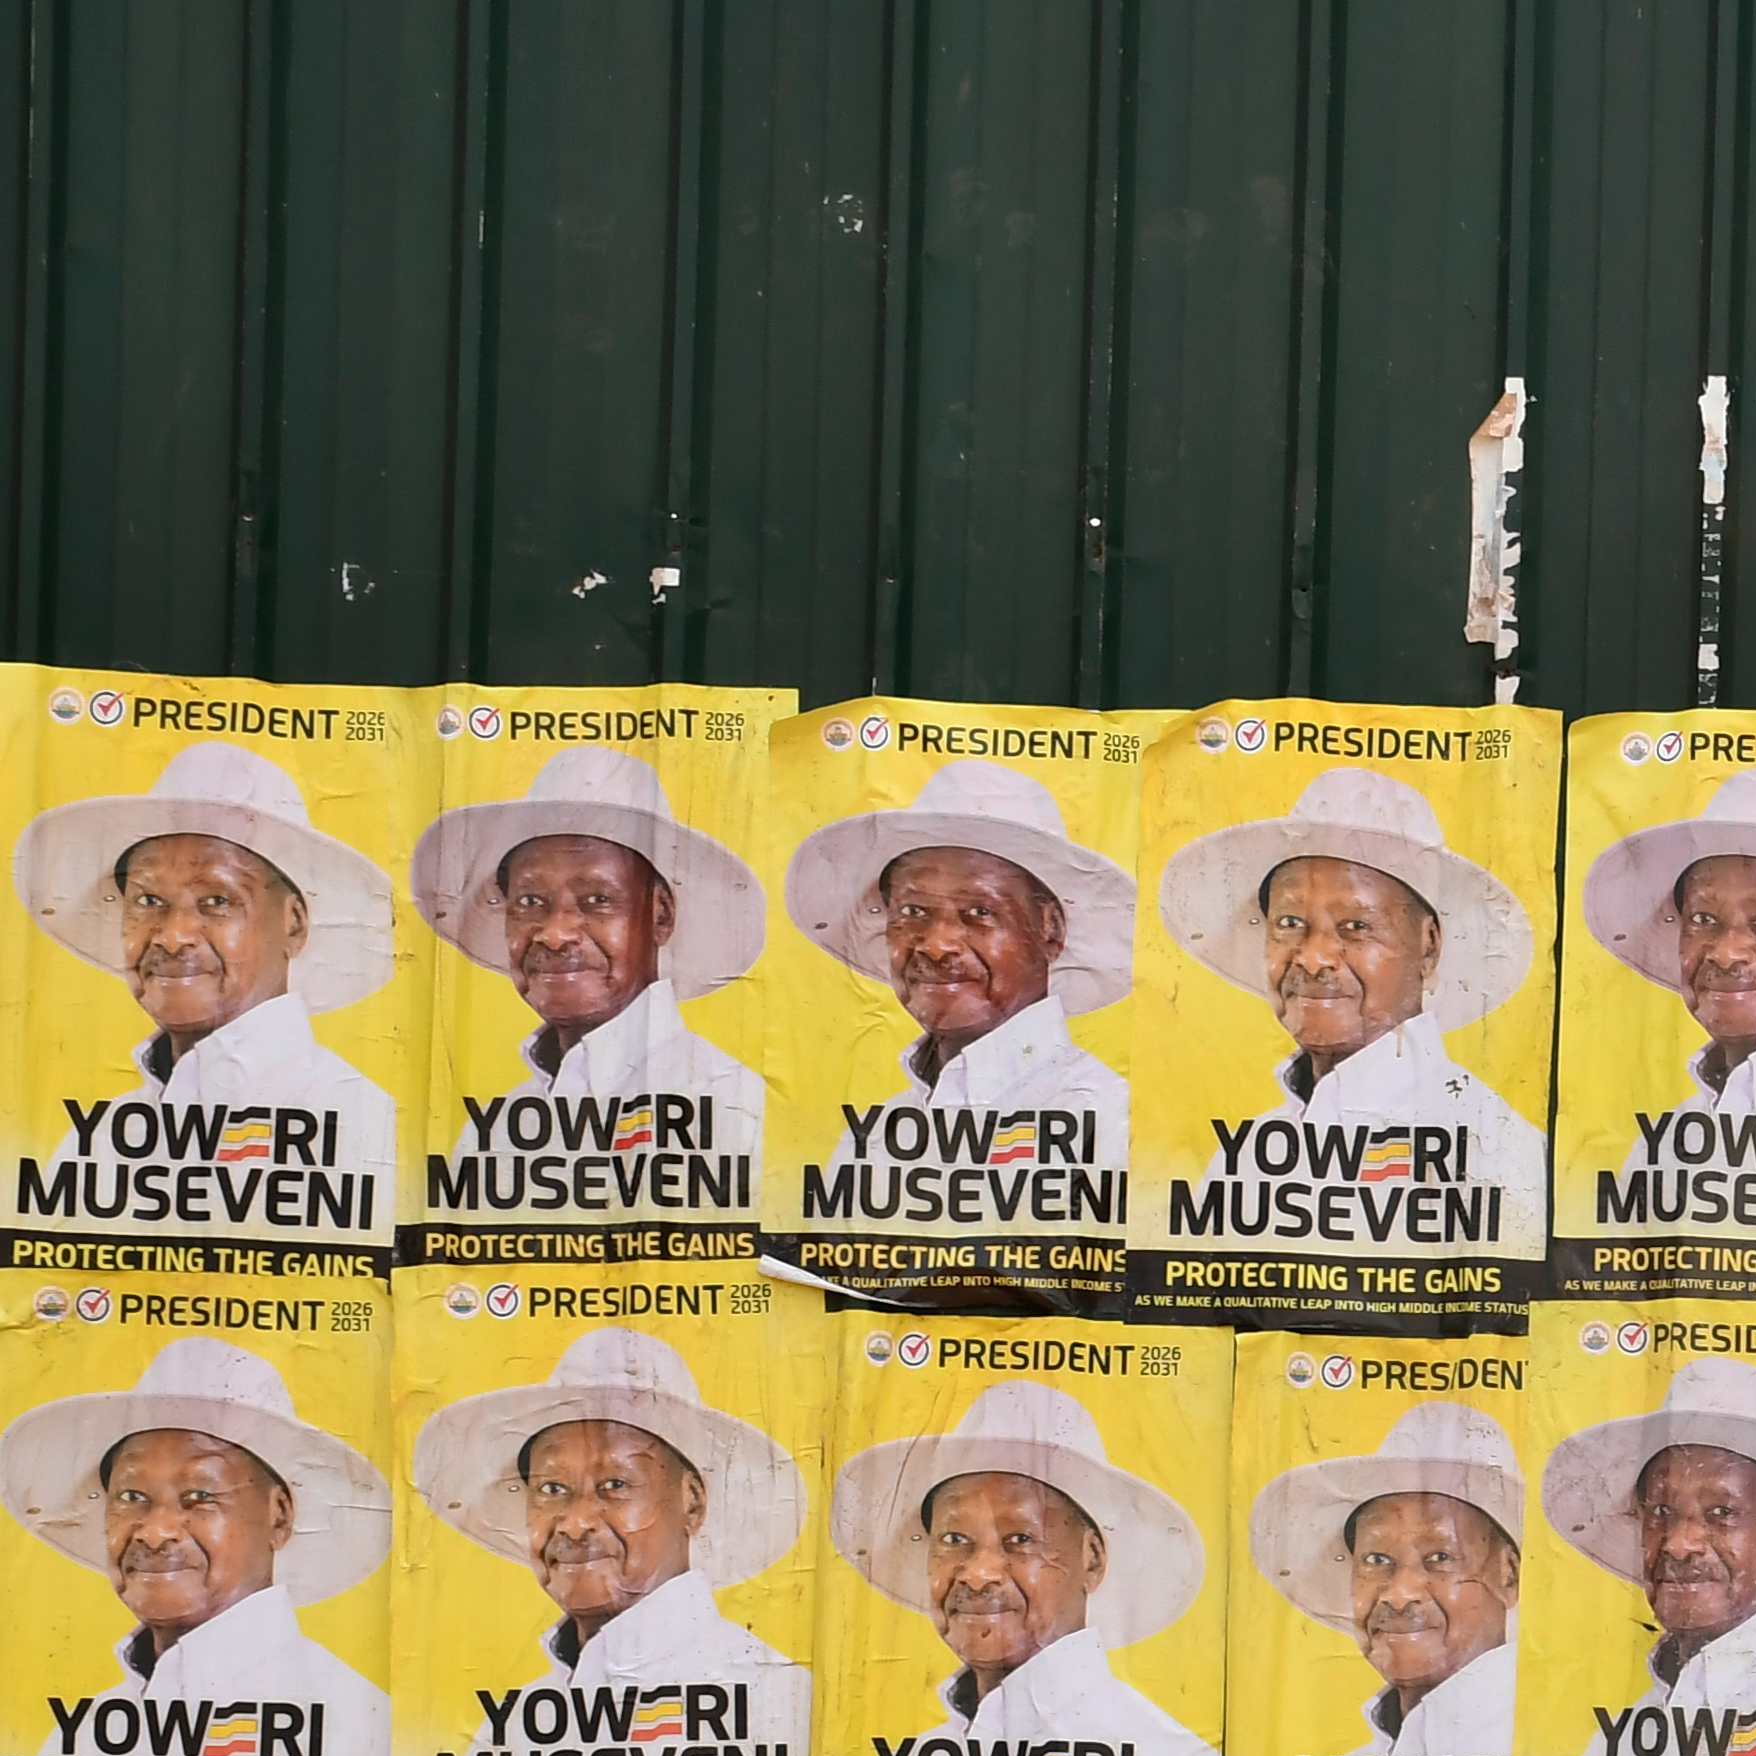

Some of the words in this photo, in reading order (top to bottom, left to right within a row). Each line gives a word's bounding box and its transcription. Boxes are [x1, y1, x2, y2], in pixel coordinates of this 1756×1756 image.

[134, 698, 339, 739] PRESIDENT
[511, 709, 699, 740] PRESIDENT
[705, 727, 741, 741] 2031
[706, 712, 744, 726] 2026
[899, 723, 1097, 759] PRESIDENT
[1275, 723, 1472, 761] PRESIDENT
[18, 1158, 373, 1229] MUSEVENI
[428, 1153, 749, 1209] MUSEVENI
[804, 1165, 1127, 1224] MUSEVENI
[1170, 1180, 1500, 1242] MUSEVENI
[530, 1285, 724, 1317] PRESIDENT
[731, 1284, 771, 1298] 2026
[731, 1300, 769, 1314] 2031
[121, 1294, 324, 1330] PRESIDENT
[939, 1339, 1135, 1375] PRESIDENT
